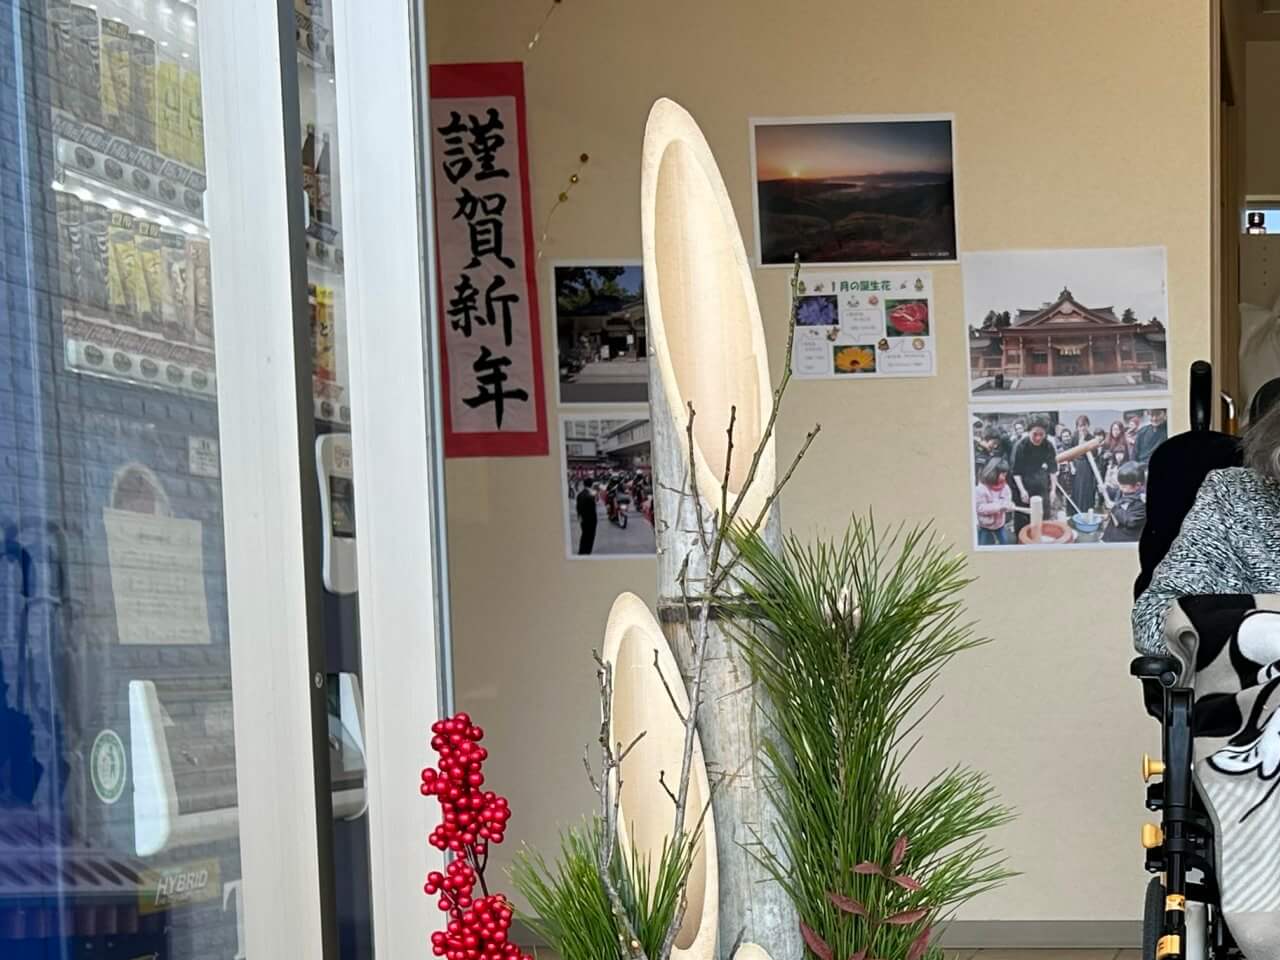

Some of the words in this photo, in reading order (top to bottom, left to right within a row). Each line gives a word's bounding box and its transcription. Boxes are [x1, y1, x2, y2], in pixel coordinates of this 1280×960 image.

[437, 107, 529, 431] 謹賀新年
[154, 870, 209, 906] HYBRID
